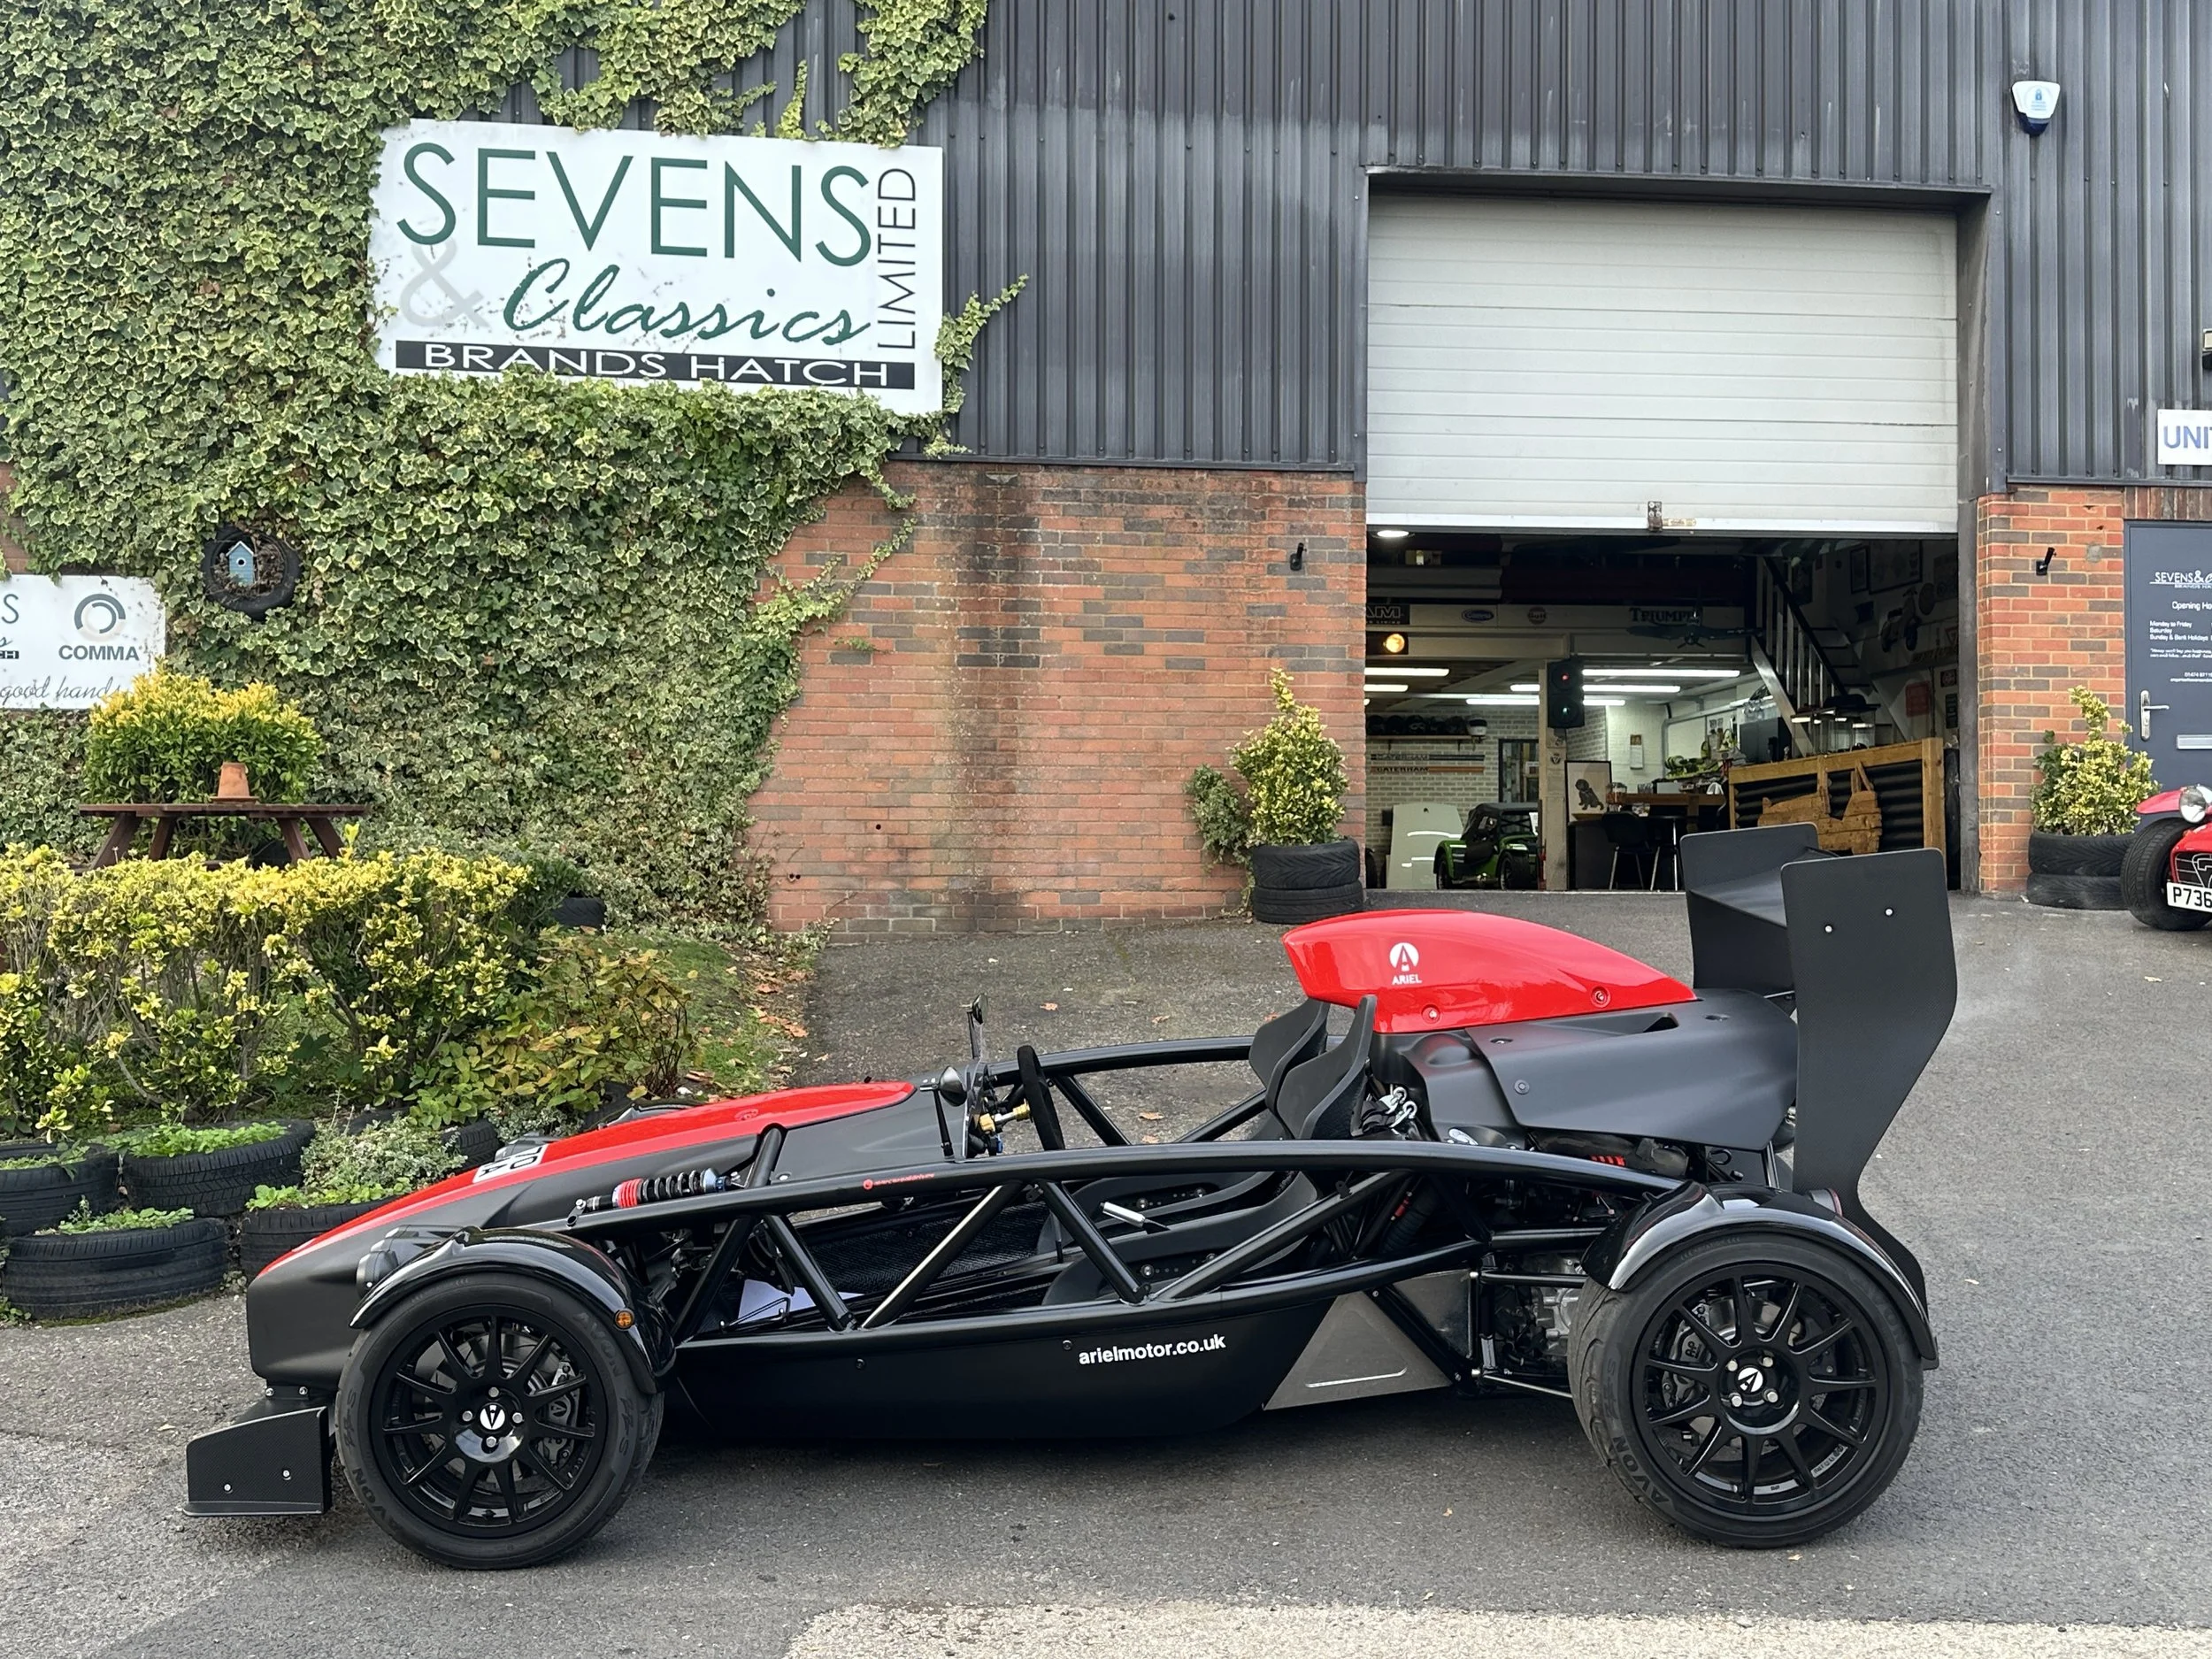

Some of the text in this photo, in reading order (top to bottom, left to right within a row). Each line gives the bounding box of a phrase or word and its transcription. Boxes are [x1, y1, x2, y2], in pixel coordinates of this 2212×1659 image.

[396, 142, 872, 267] SEVENS
[877, 167, 917, 350] LIMITED
[397, 241, 872, 345] & Classics
[425, 342, 888, 387] BRANDS HATCH
[2163, 426, 2212, 449] UNI
[2172, 601, 2201, 611] Opening
[58, 644, 140, 662] COMMA
[2173, 886, 2212, 909] P736
[1391, 973, 1423, 986] ARIEL
[1079, 1333, 1226, 1365] arielmotor.co.uk
[1612, 1435, 1671, 1503] AVON
